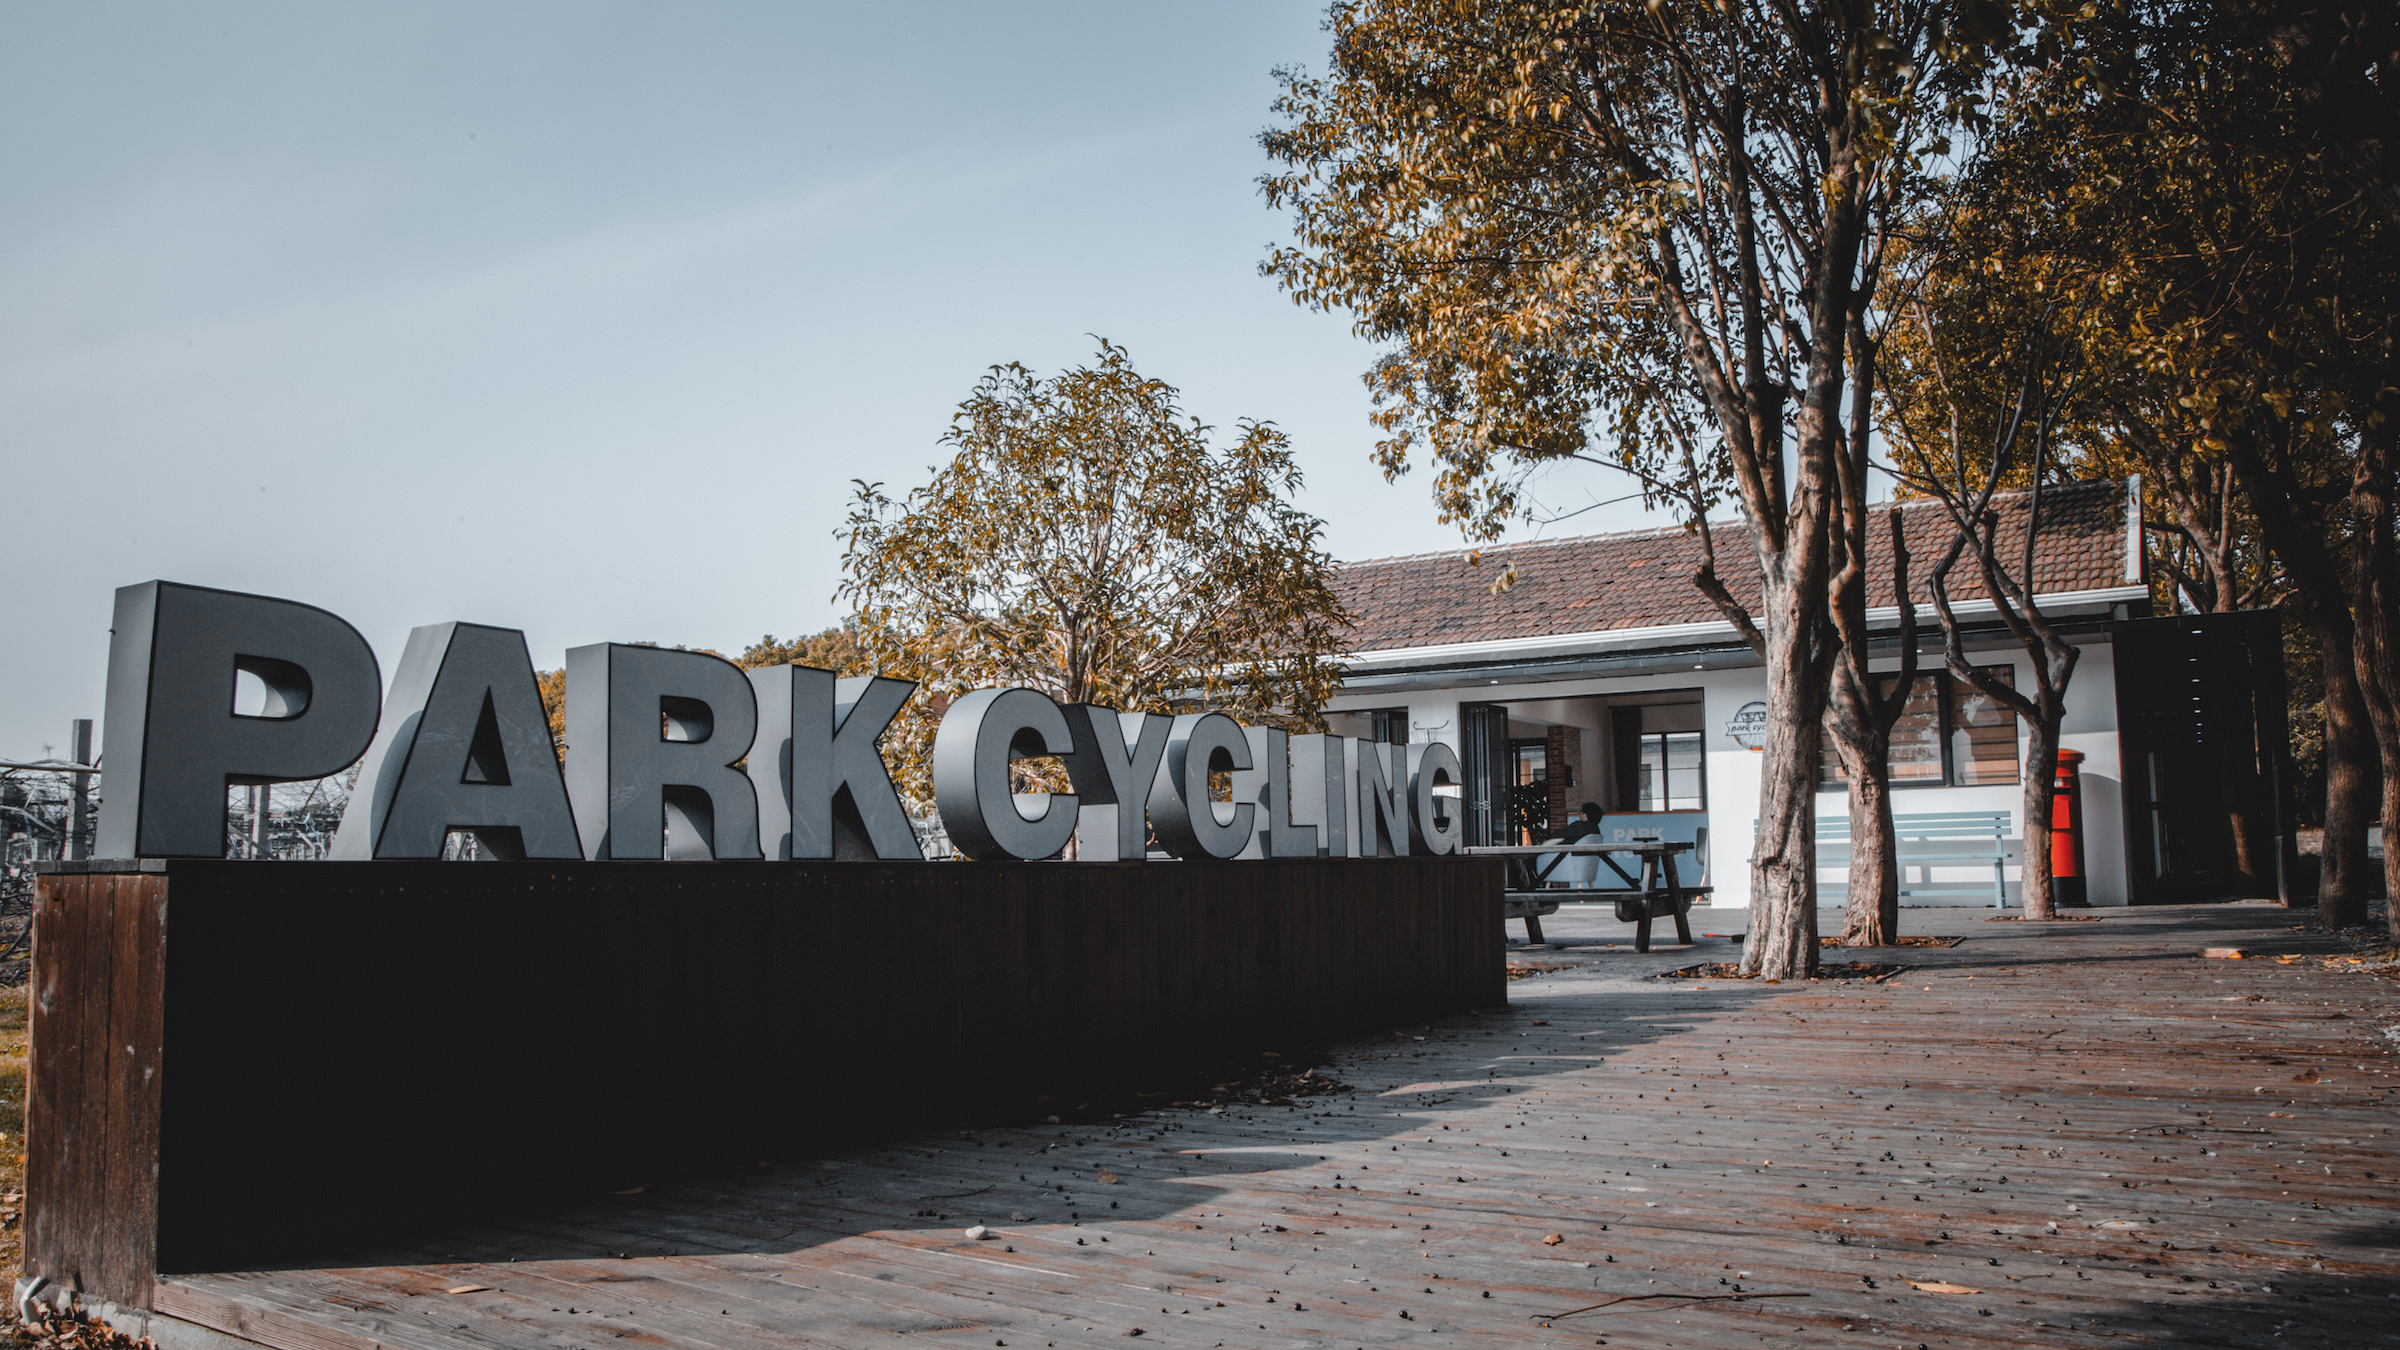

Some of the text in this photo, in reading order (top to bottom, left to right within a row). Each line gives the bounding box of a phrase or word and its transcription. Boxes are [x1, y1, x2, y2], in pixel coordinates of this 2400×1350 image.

[96, 579, 1463, 861] PARK CYCLING
[1613, 827, 1665, 842] PARK
